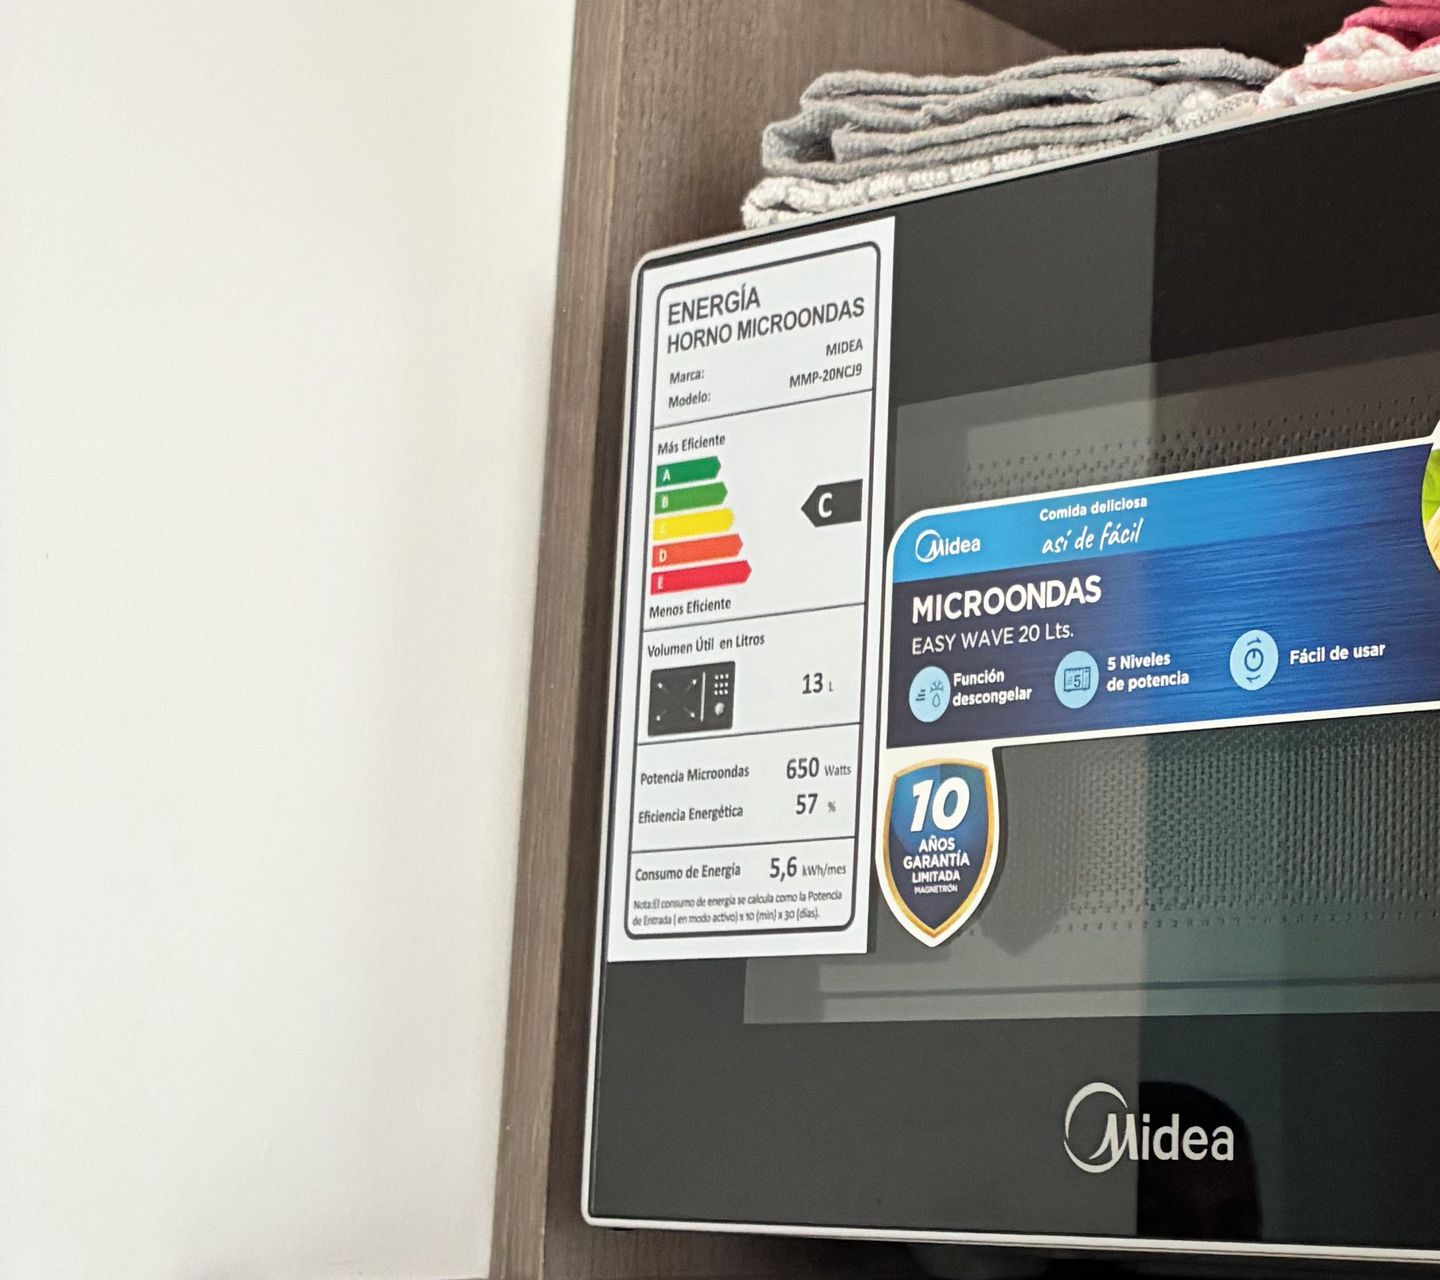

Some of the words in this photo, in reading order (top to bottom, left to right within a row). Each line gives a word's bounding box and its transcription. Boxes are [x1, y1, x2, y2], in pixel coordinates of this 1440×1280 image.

[668, 283, 761, 326] ENERGÍA
[667, 324, 732, 354] HORNO
[737, 297, 865, 340] MICROONDAS
[670, 369, 704, 385] Marca:
[826, 338, 863, 356] MIDEA
[668, 390, 710, 409] Modelo:
[789, 363, 862, 388] MMP-20NCJ9
[658, 441, 678, 455] Más
[682, 434, 725, 452] Eficiente
[663, 470, 670, 481] A
[661, 497, 668, 508] B
[818, 493, 832, 517] C
[1040, 505, 1087, 521] Comida
[1091, 496, 1147, 515] deliciosa
[915, 529, 981, 563] Midea
[1042, 529, 1072, 554] así
[1075, 526, 1095, 551] de
[1100, 518, 1144, 550] fácil
[659, 549, 667, 561] D
[658, 577, 663, 589] E
[649, 601, 683, 619] Menos
[687, 597, 731, 616] Eficiente
[912, 575, 1102, 624] MICROONDAS
[648, 642, 692, 658] Volumen
[696, 636, 714, 653] Útil
[720, 639, 732, 649] en
[736, 633, 765, 648] Litros
[912, 633, 956, 655] EASY
[962, 627, 1014, 649] WAVE
[1019, 624, 1040, 643] 20
[1046, 621, 1073, 640] Lts.
[1107, 657, 1116, 671] 5
[1120, 652, 1170, 669] Niveles
[1290, 647, 1325, 665] Fácil
[1330, 645, 1349, 661] de
[1353, 643, 1386, 659] usar
[802, 673, 823, 694] 13
[954, 669, 1004, 686] Función
[1074, 675, 1081, 687] 5
[1107, 676, 1124, 692] de
[1128, 671, 1189, 692] potencia
[953, 686, 1032, 707] descongelar
[641, 768, 684, 785] Potencia
[687, 764, 749, 782] Microondas
[786, 756, 819, 779] 650
[825, 764, 851, 776] Watts
[639, 807, 685, 824] Eficiencia
[689, 804, 743, 822] Energética
[796, 793, 818, 815] 57
[911, 777, 970, 832] 10
[919, 836, 955, 853] AÑOS
[635, 867, 683, 882] Consumo
[686, 865, 698, 878] de
[702, 863, 740, 880] Energía
[770, 856, 797, 882] 5,6
[903, 850, 970, 869] GARANTÍA
[912, 870, 960, 884] LIMITADA
[1063, 1082, 1234, 1174] Midea
